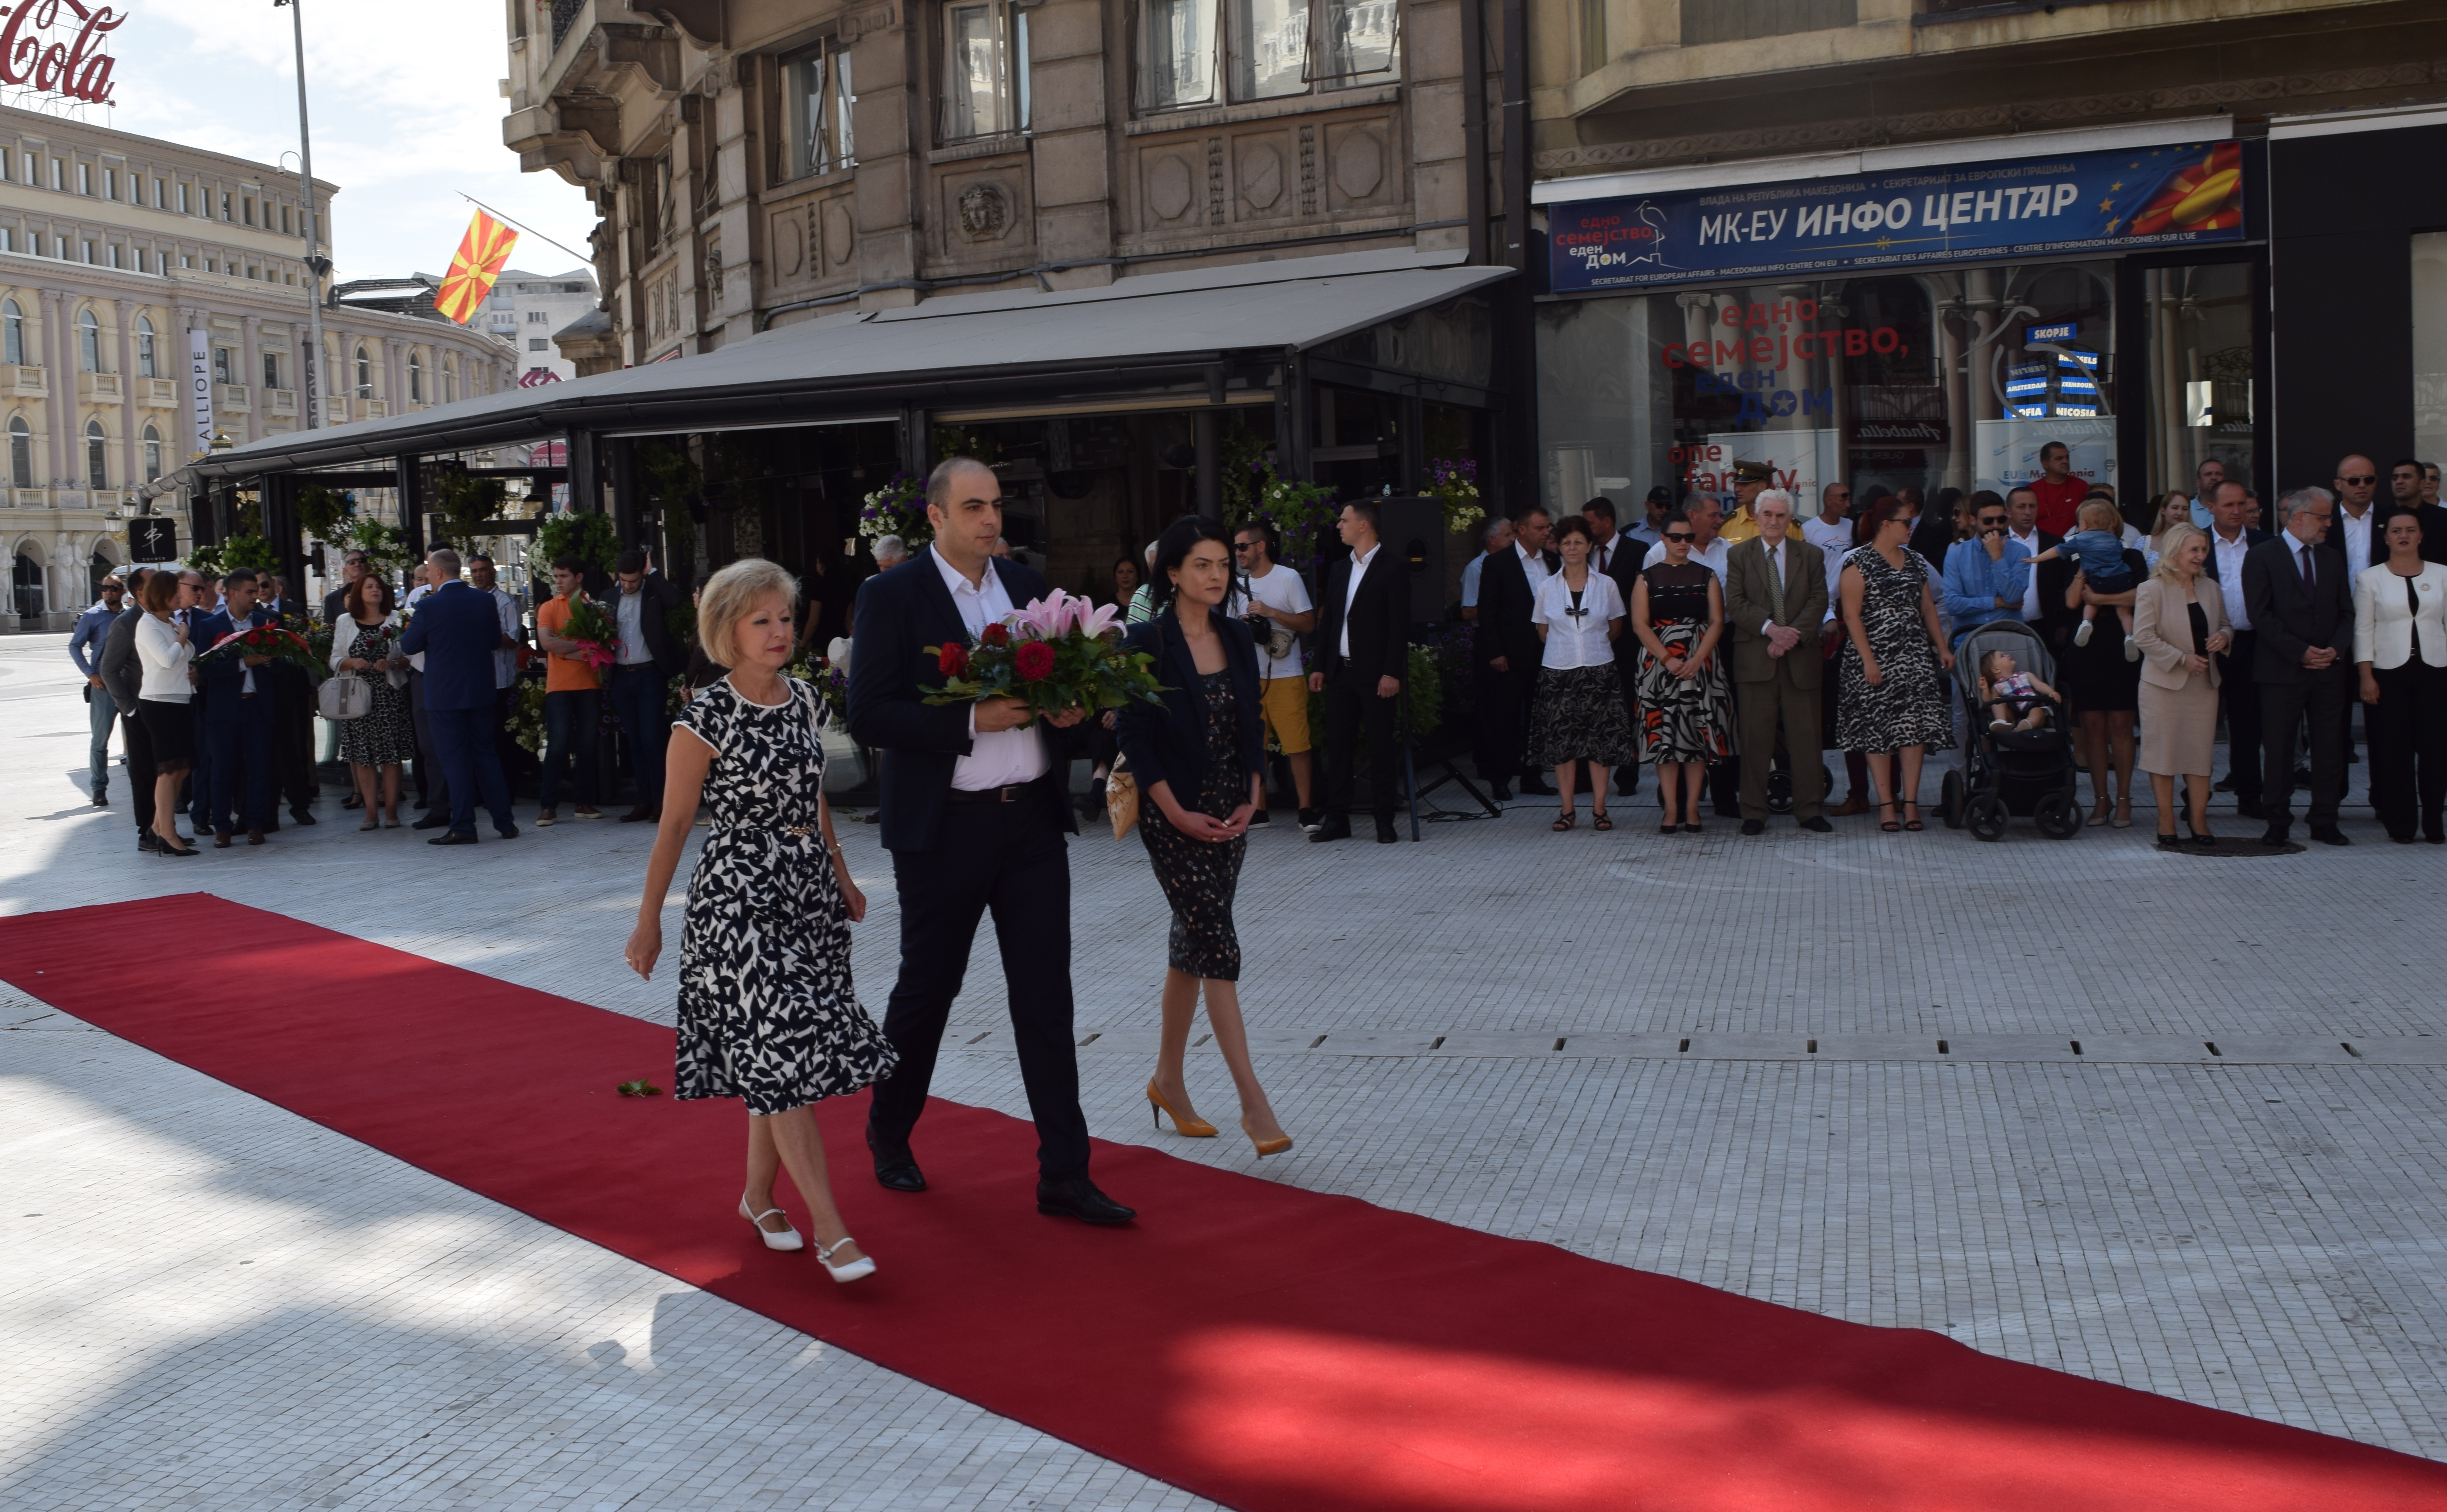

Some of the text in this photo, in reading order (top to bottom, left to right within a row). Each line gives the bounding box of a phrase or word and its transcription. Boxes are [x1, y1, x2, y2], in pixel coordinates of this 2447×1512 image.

[1700, 163, 2076, 206] ВЛАДА НА РЕПУБЛИКА МАКЕДОНИЈА СЕКРЕТАРИЈАТ ЗА ЕВРОПСКИ ПРАШАЊА
[1580, 216, 1620, 229] едно
[1699, 183, 2078, 245] МК-ЕУ ИНФО ЦЕНТАР
[1556, 226, 1655, 246] семејство,
[1569, 245, 1603, 257] еден
[1591, 276, 1633, 285] SECRETARIAT
[1650, 272, 1686, 281] EUROPEAN
[1687, 269, 1715, 278] AFFAIRS
[1720, 264, 1766, 275] MACEDONIAN
[1785, 261, 1813, 270] CENTRE
[1854, 255, 1901, 264] SECRETARIAT
[1918, 250, 1952, 260] AFFAIRES
[1954, 246, 2008, 258] EUROPEENNES
[2013, 244, 2044, 253] CENTRE
[2045, 239, 2106, 250] D'INFORMATION
[2107, 235, 2160, 246] MACEDONIEN
[2162, 233, 2177, 242] SUR
[2179, 232, 2196, 240] L'UE
[1721, 299, 1819, 331] едно
[2034, 327, 2069, 339] SKOPJE
[1662, 324, 1909, 371] семејство,
[2059, 354, 2097, 365] BRSELS
[1698, 369, 1775, 396] еден
[2007, 382, 2047, 392] AMSTERDAM
[2012, 408, 2042, 417] OFIA
[2056, 408, 2096, 417] NICOSIA
[1668, 444, 1721, 464] one
